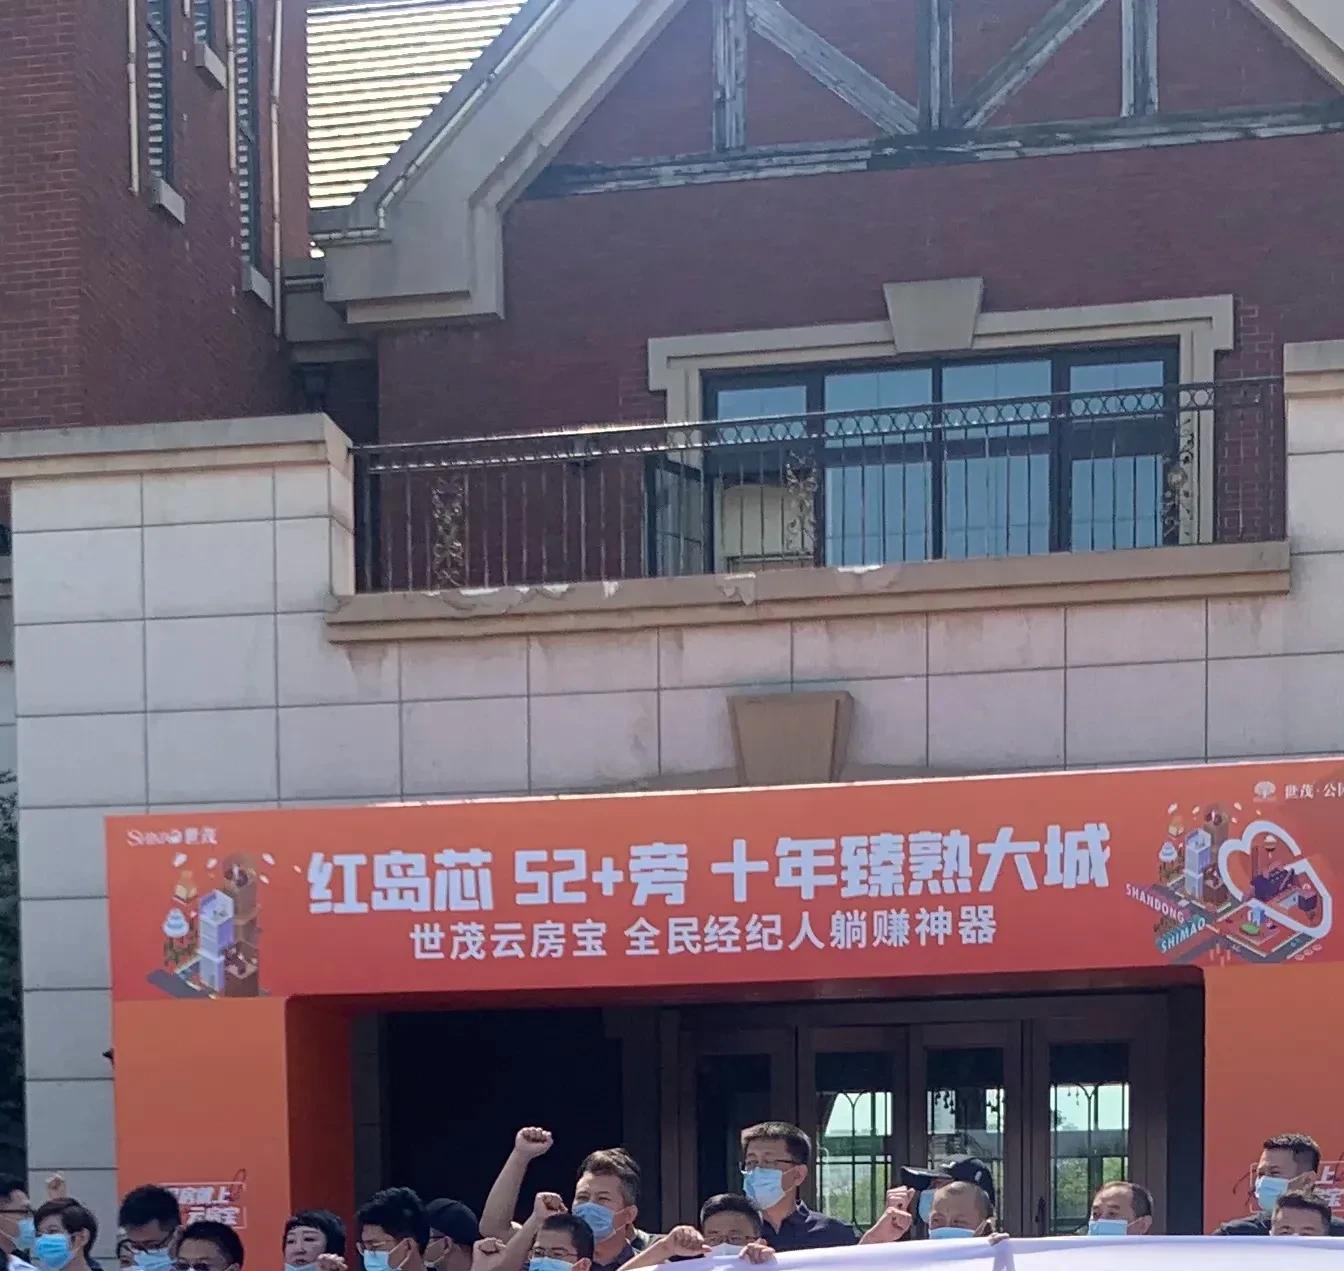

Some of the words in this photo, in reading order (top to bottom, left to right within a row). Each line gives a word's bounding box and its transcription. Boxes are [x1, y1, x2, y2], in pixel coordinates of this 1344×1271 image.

[307, 848, 494, 914] 红岛芯
[514, 842, 689, 906] 52+旁
[710, 823, 1111, 903] 十年臻熟大城
[1126, 883, 1185, 924] SHANDONG
[409, 918, 608, 961] 世茂云房宝
[623, 905, 998, 956] 全民经纪人躺赚神器
[1160, 917, 1206, 953] SHIMAO
